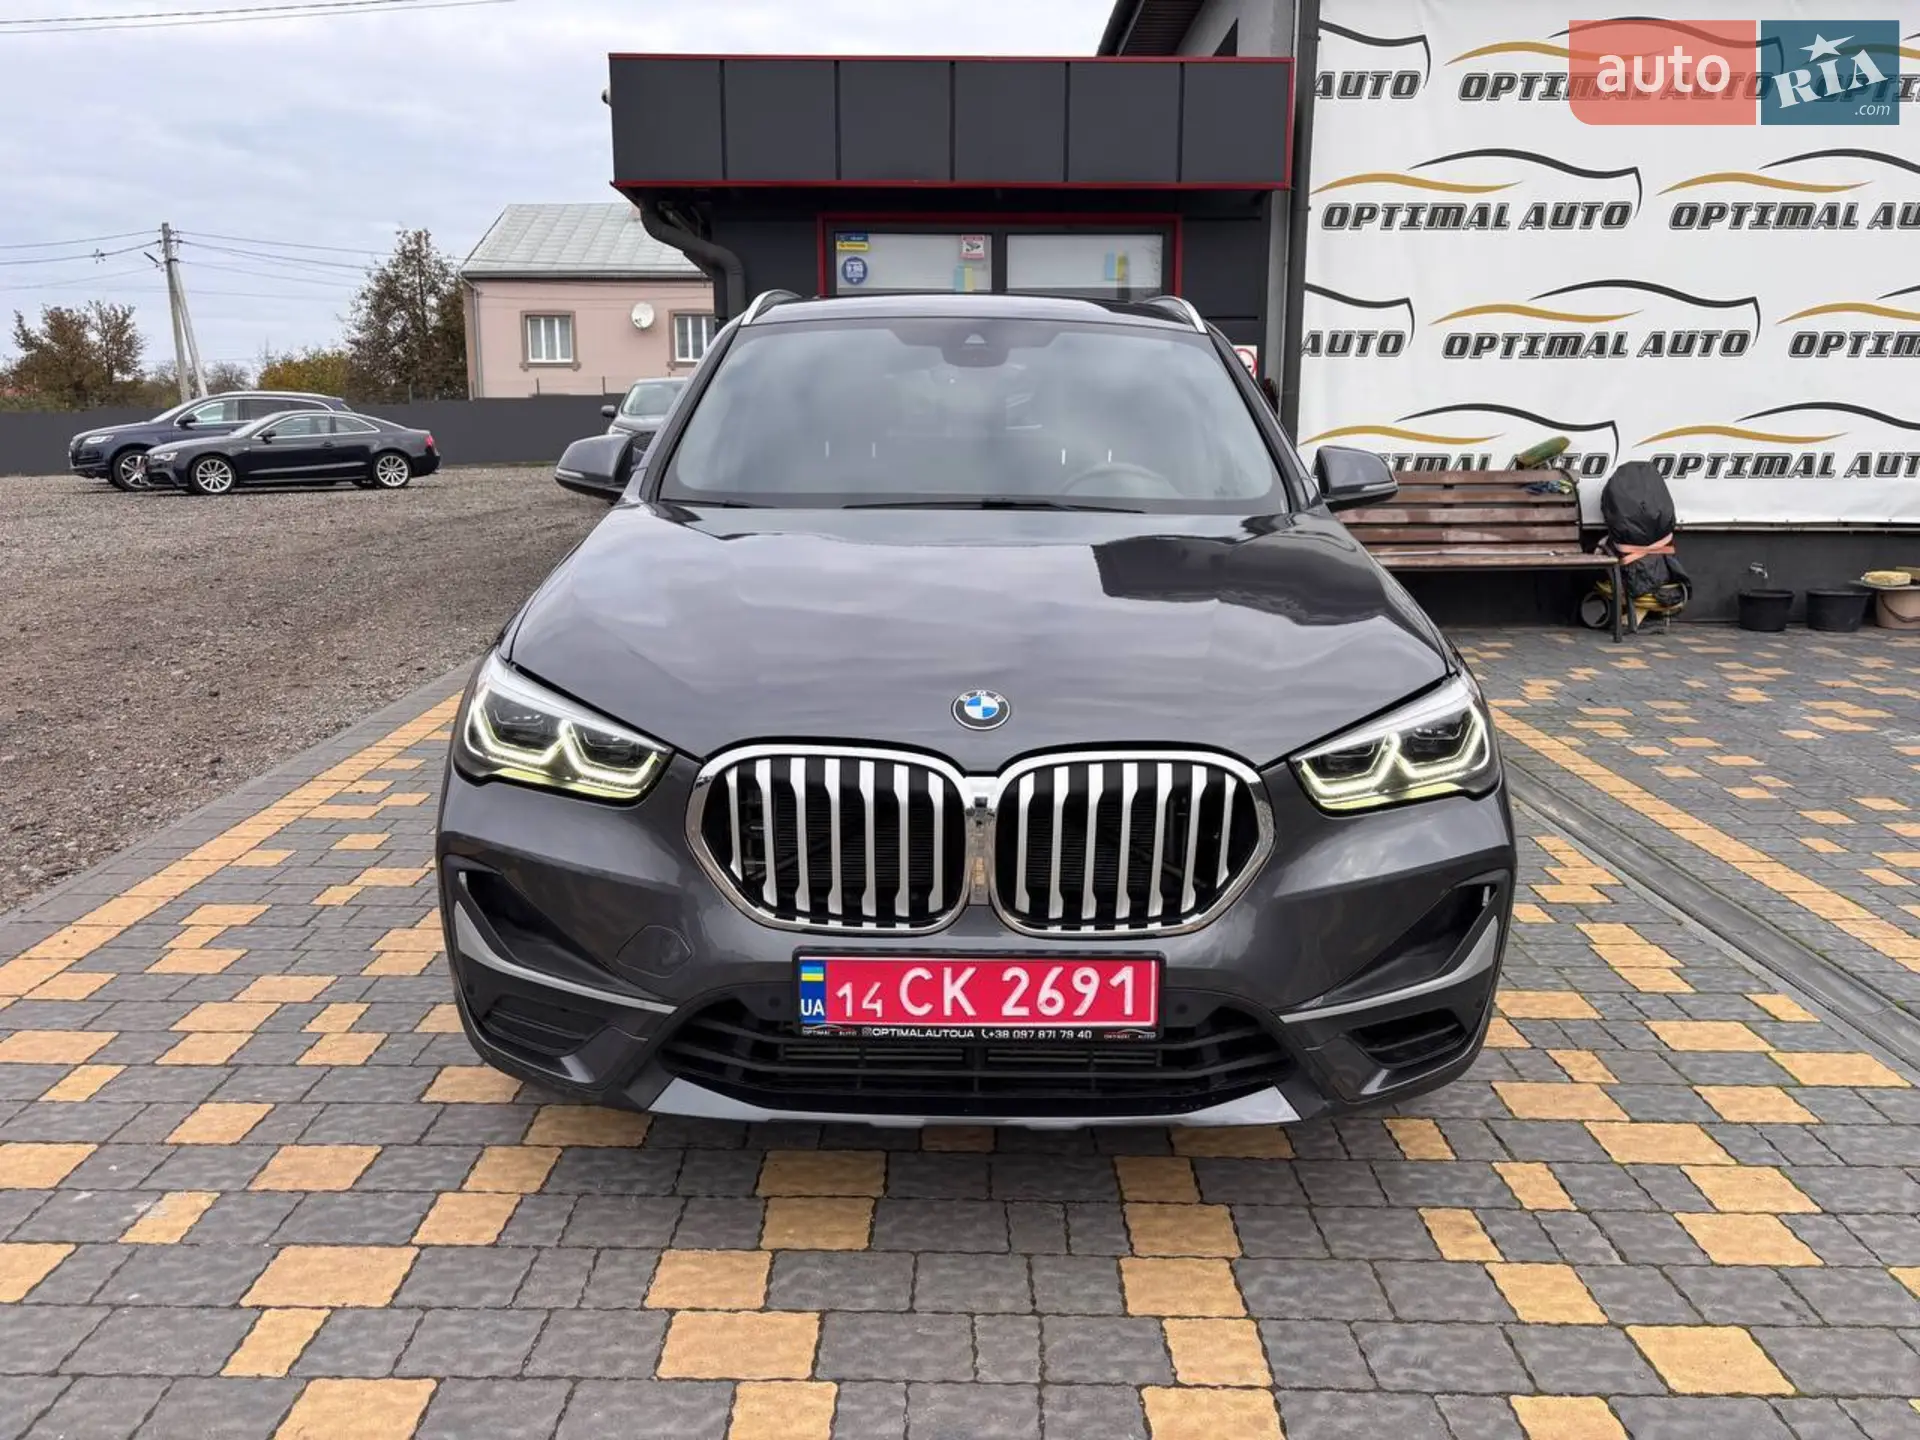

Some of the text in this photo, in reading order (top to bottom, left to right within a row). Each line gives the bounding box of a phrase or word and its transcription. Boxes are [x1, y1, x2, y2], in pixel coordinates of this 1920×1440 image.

[1314, 71, 1421, 100] AUTO
[1321, 201, 1632, 230] OPTIMAL AUTO
[1669, 202, 1859, 230] OPTIMAL
[1300, 330, 1407, 358] AUTO
[1441, 330, 1751, 359] OPTIMAL AUTO
[1651, 453, 1836, 480] OPTIMAL
[835, 965, 1134, 1018] 14 CK 2691
[800, 998, 826, 1017] UA
